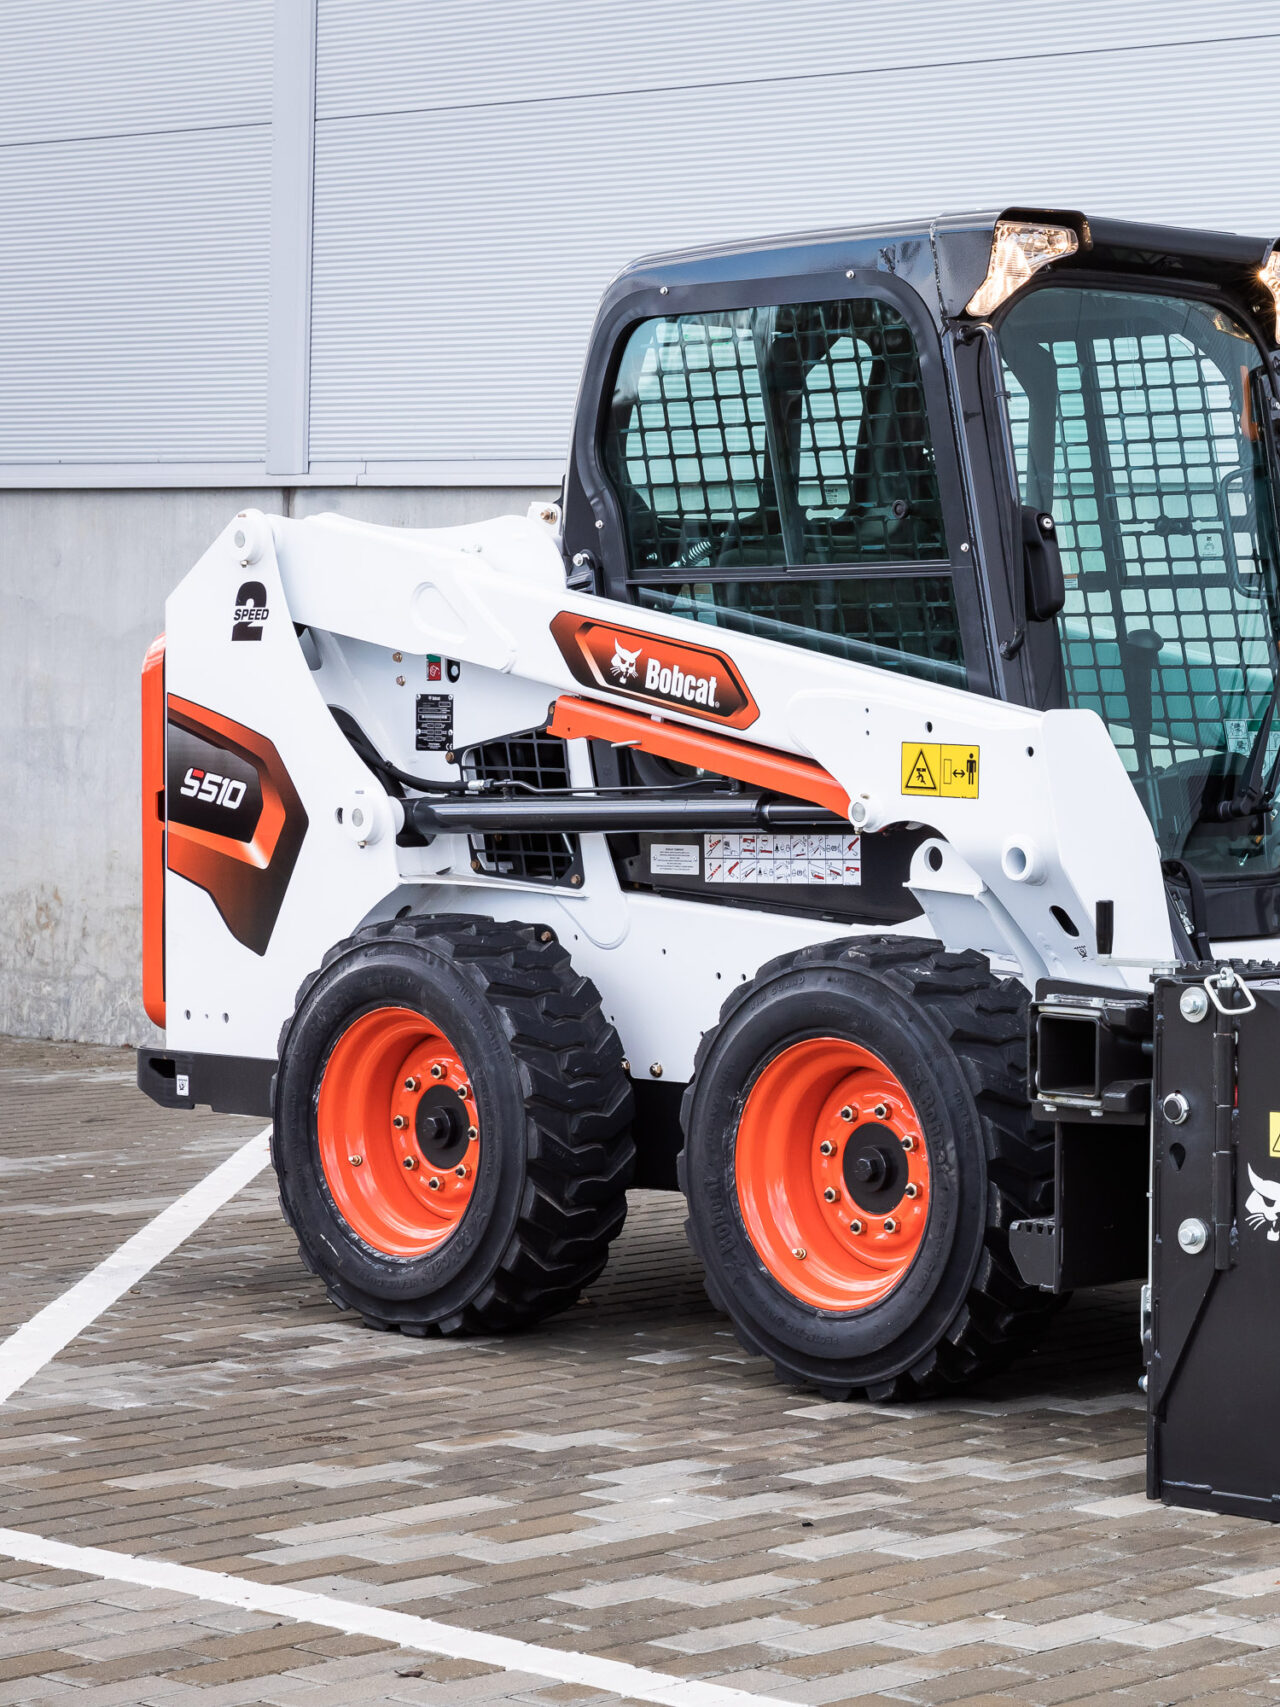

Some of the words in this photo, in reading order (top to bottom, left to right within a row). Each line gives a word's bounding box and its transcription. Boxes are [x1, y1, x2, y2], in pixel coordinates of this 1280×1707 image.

[232, 581, 267, 641] 2
[233, 608, 270, 621] SPEED
[645, 658, 718, 707] Bobcat
[180, 767, 247, 810] S510
